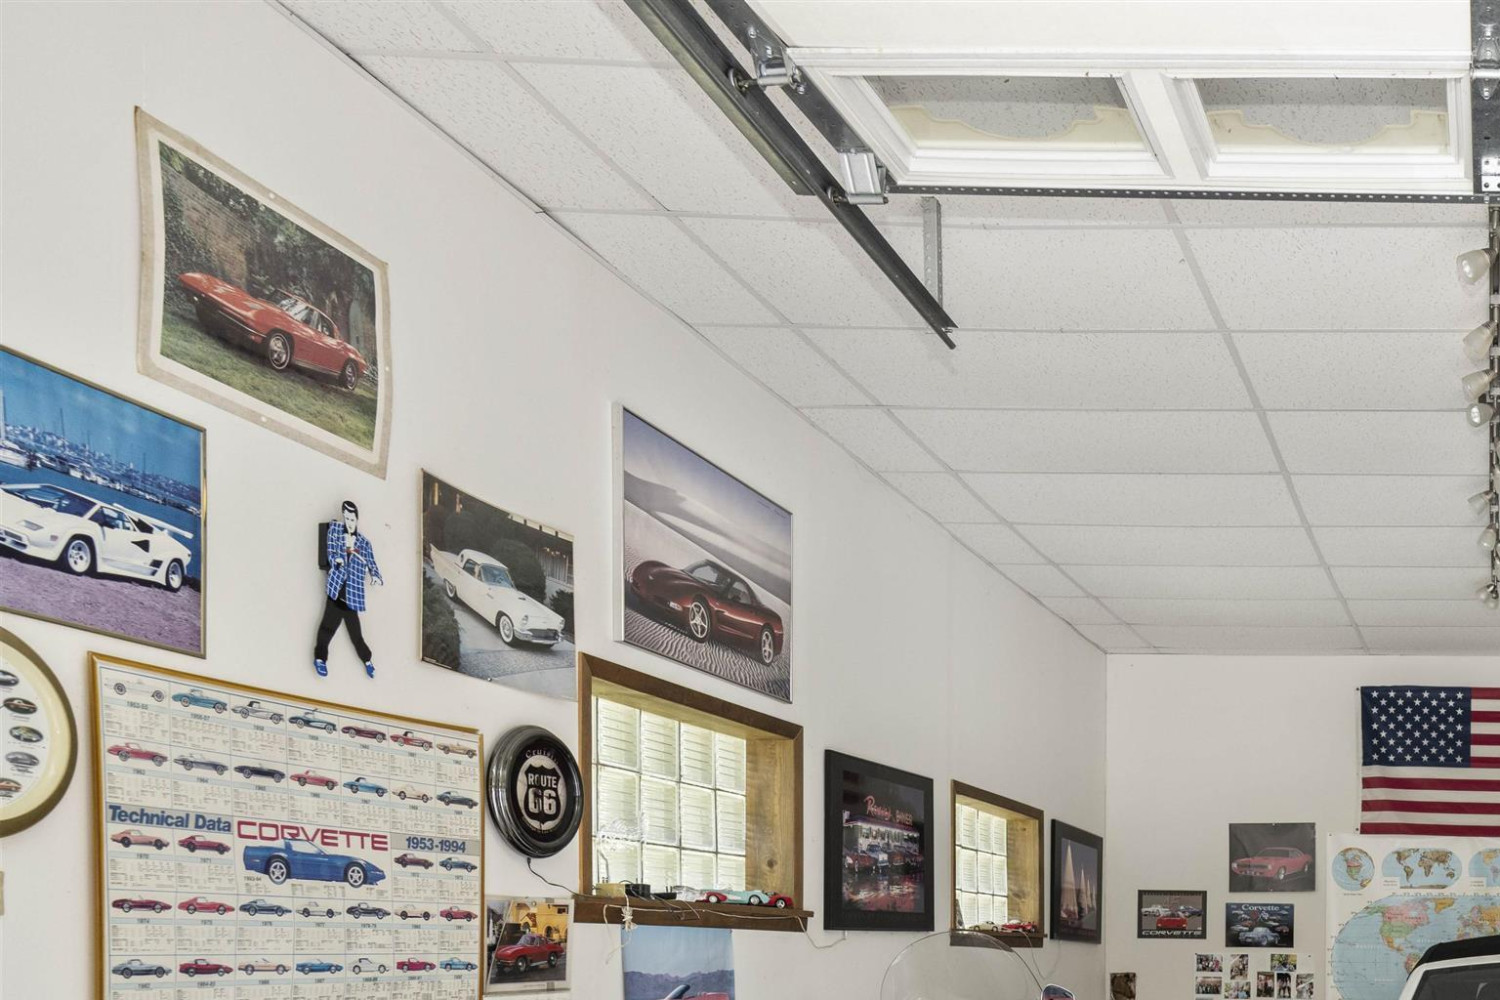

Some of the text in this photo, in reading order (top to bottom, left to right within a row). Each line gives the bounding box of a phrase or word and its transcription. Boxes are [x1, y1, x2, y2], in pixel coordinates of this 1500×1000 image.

[528, 773, 557, 788] ROUTE
[528, 787, 557, 815] 66
[108, 805, 232, 832] Technical Data
[237, 820, 388, 851] CORVETTE
[405, 836, 467, 853] 1953-1994
[1241, 903, 1280, 911] Corvette
